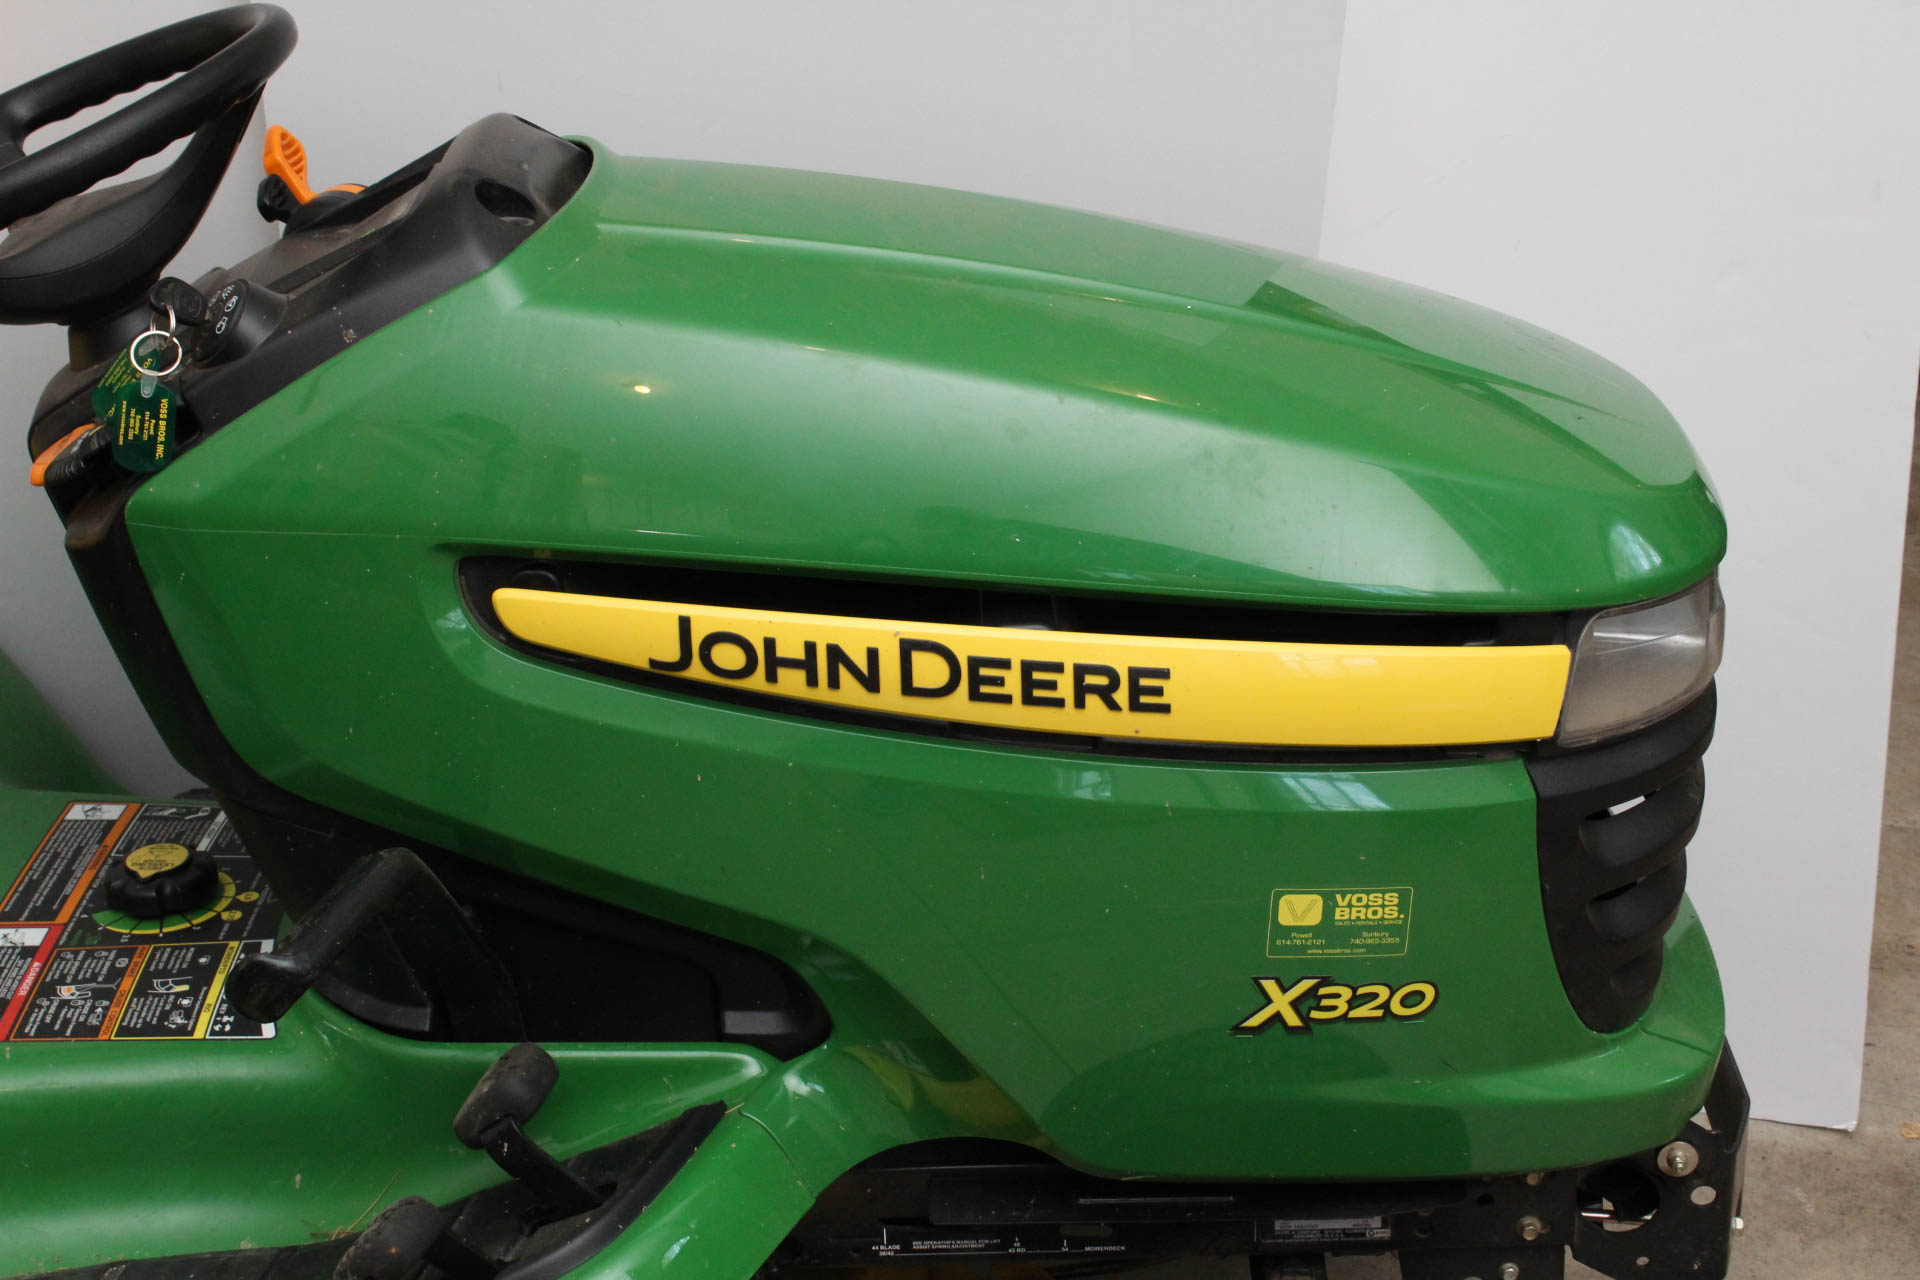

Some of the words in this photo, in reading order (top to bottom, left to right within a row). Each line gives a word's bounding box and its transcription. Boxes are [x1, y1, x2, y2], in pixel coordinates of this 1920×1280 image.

[160, 398, 168, 419] VOSS
[157, 420, 167, 443] BROS.
[156, 444, 164, 460] INC.
[649, 614, 880, 693] JOHN
[899, 637, 1171, 714] DEERE
[1335, 892, 1400, 907] VOSS
[1334, 906, 1405, 920] BROS.
[18, 968, 39, 996] DANGER
[1234, 977, 1438, 1032] X320
[103, 1010, 118, 1036] CONTROL
